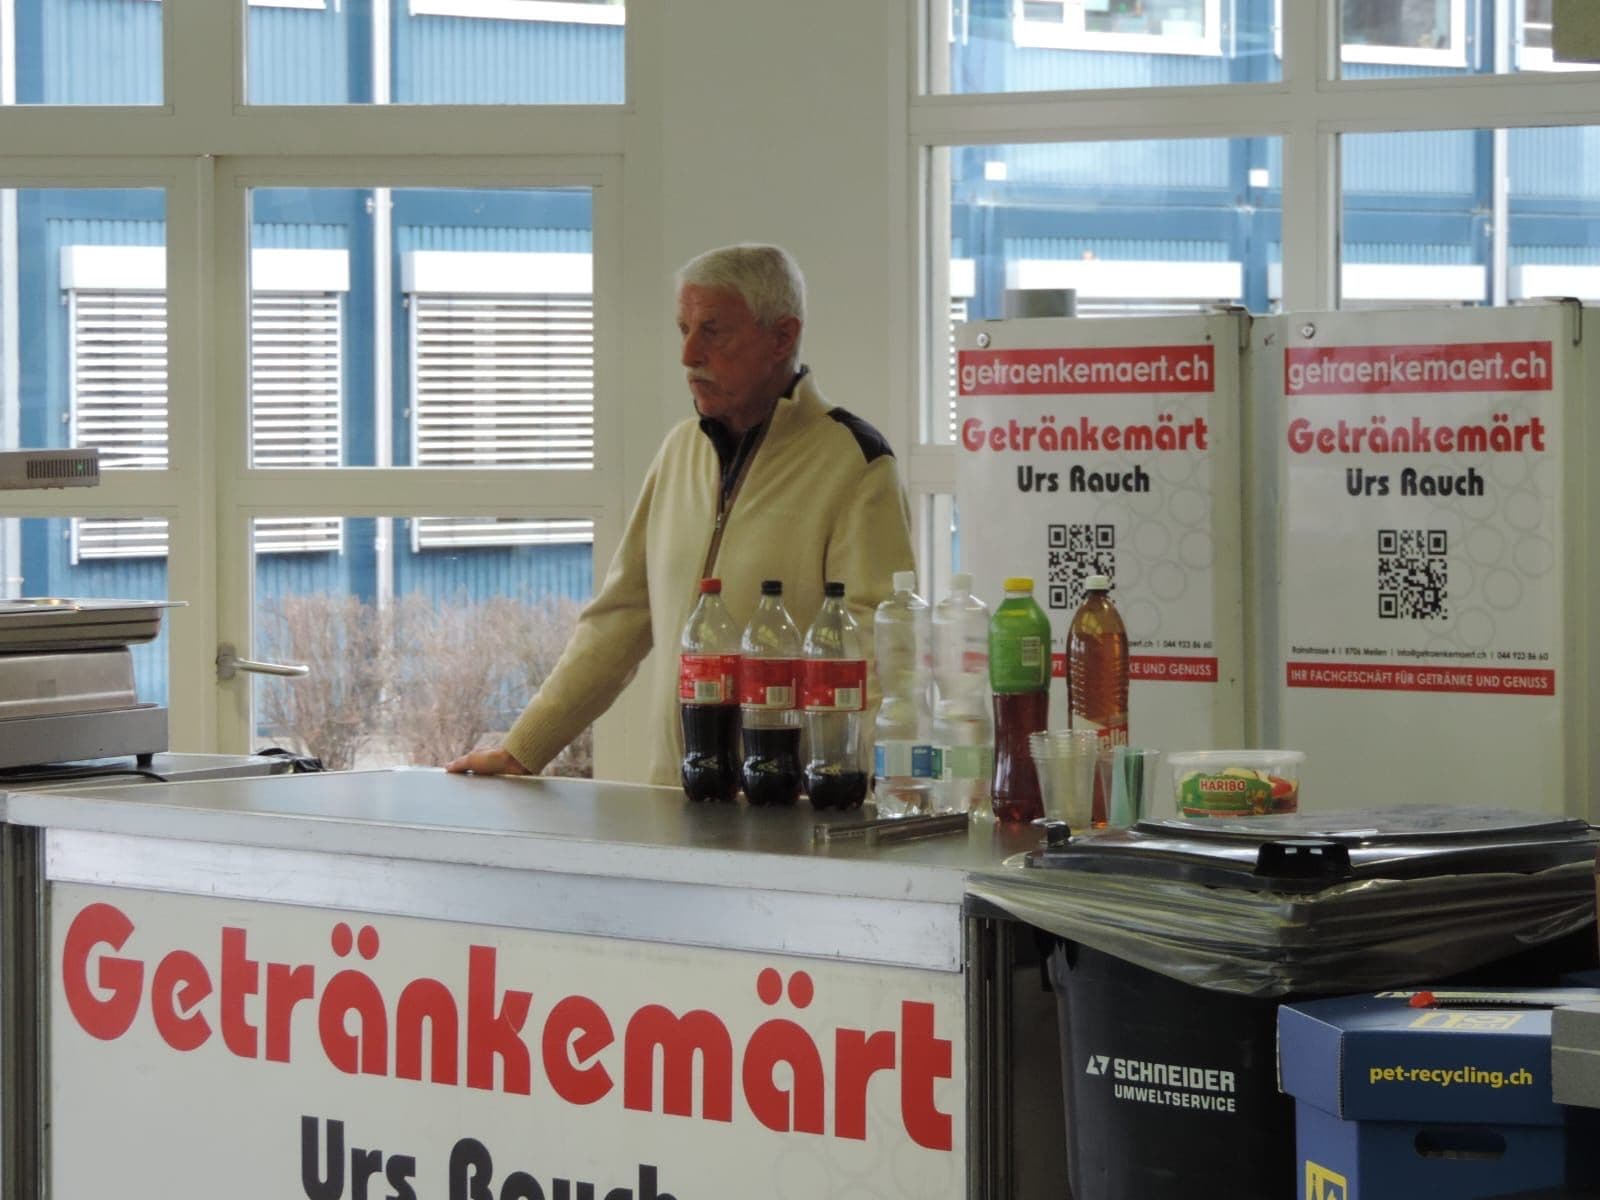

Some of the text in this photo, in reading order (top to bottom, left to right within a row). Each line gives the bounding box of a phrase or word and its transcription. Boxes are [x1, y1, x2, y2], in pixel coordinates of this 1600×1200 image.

[961, 354, 1209, 391] getraenkemaert.ch
[1288, 351, 1547, 389] getraenkemaert.ch
[962, 415, 1209, 452] Getränkemärt
[1287, 413, 1545, 454] Getränkemärt
[1017, 464, 1150, 492] Urs Rauch
[1346, 467, 1484, 496] Urs Rauch
[1142, 663, 1166, 674] UND
[1168, 663, 1212, 676] GENUSS
[1291, 668, 1548, 689] IHR FACHGESCHÄFT FÜR GETRÄNKE UND GENUSS
[1200, 780, 1246, 792] HARIBO
[62, 902, 953, 1152] Getränkemärt
[1113, 1057, 1236, 1092] SCHNEIDER
[1369, 1065, 1533, 1088] pet-recycling.ch
[1113, 1083, 1236, 1113] UMWELTSERVICE
[301, 1115, 416, 1200] Urs
